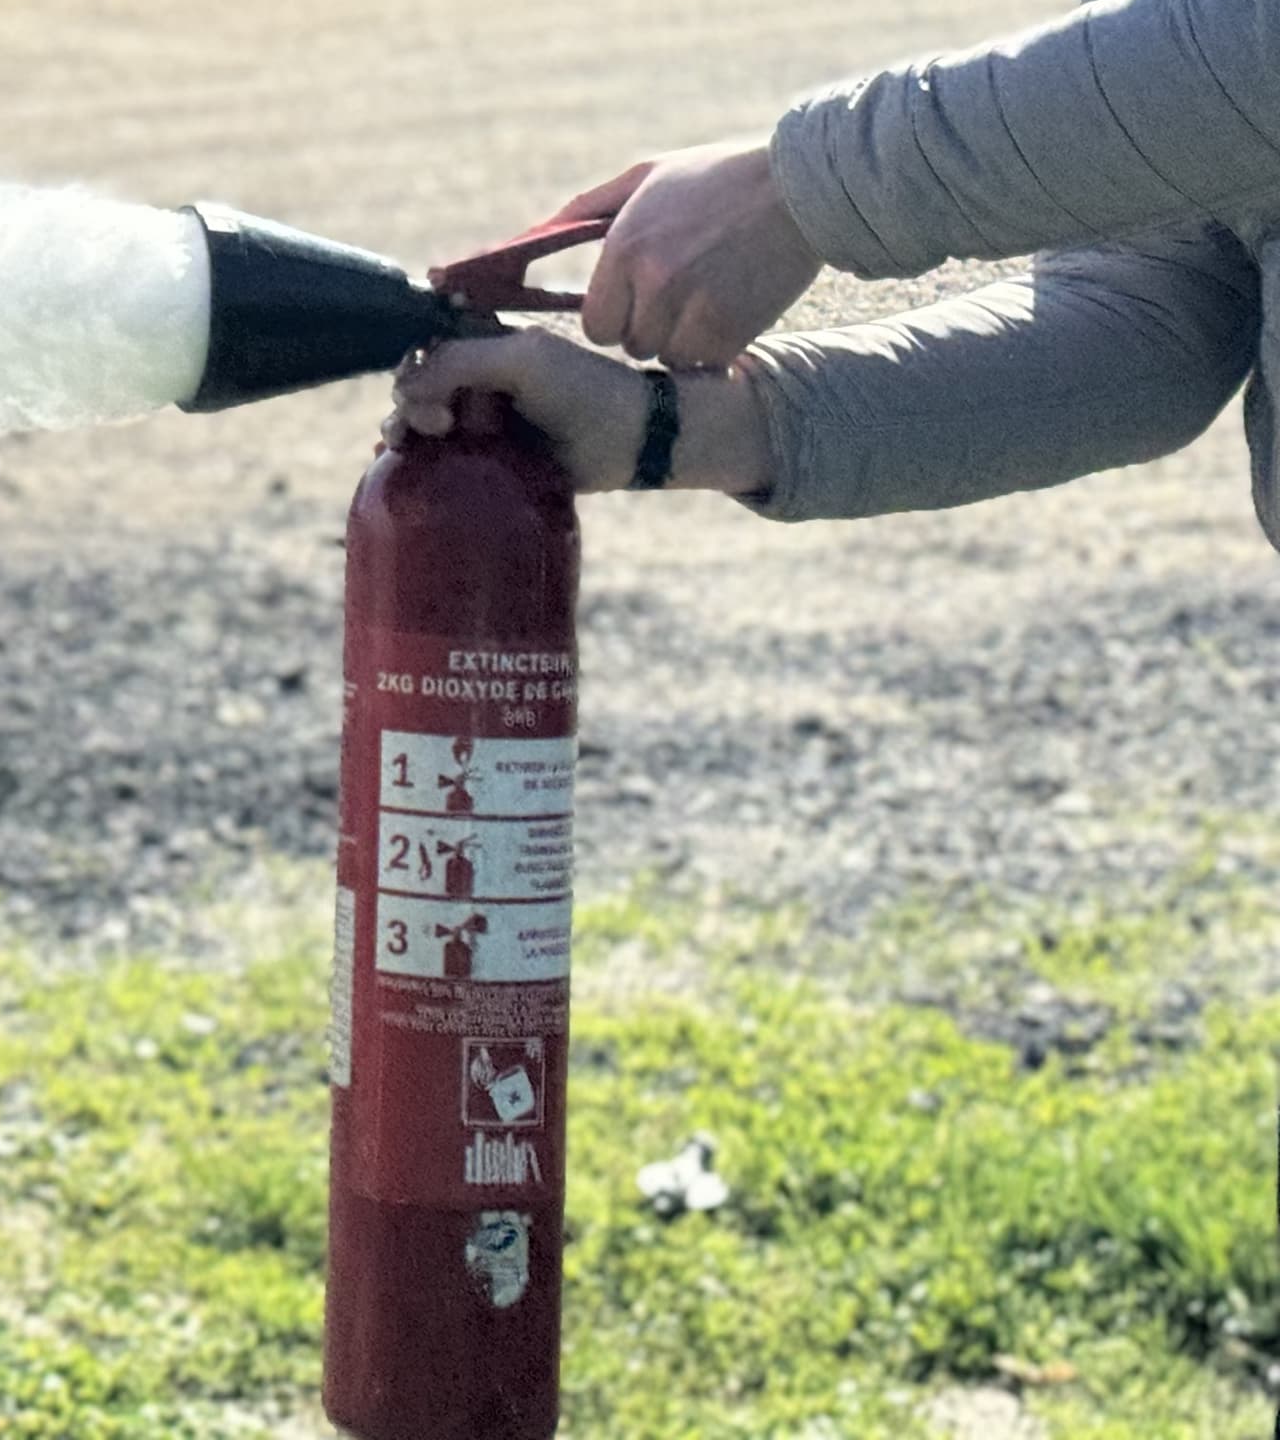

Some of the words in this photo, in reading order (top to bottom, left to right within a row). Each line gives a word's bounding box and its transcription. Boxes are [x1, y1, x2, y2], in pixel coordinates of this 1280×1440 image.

[377, 672, 413, 694] 2KG
[421, 677, 519, 701] DIOXYDE
[391, 753, 414, 788] 1
[388, 834, 410, 871] 2
[386, 920, 409, 955] 3
